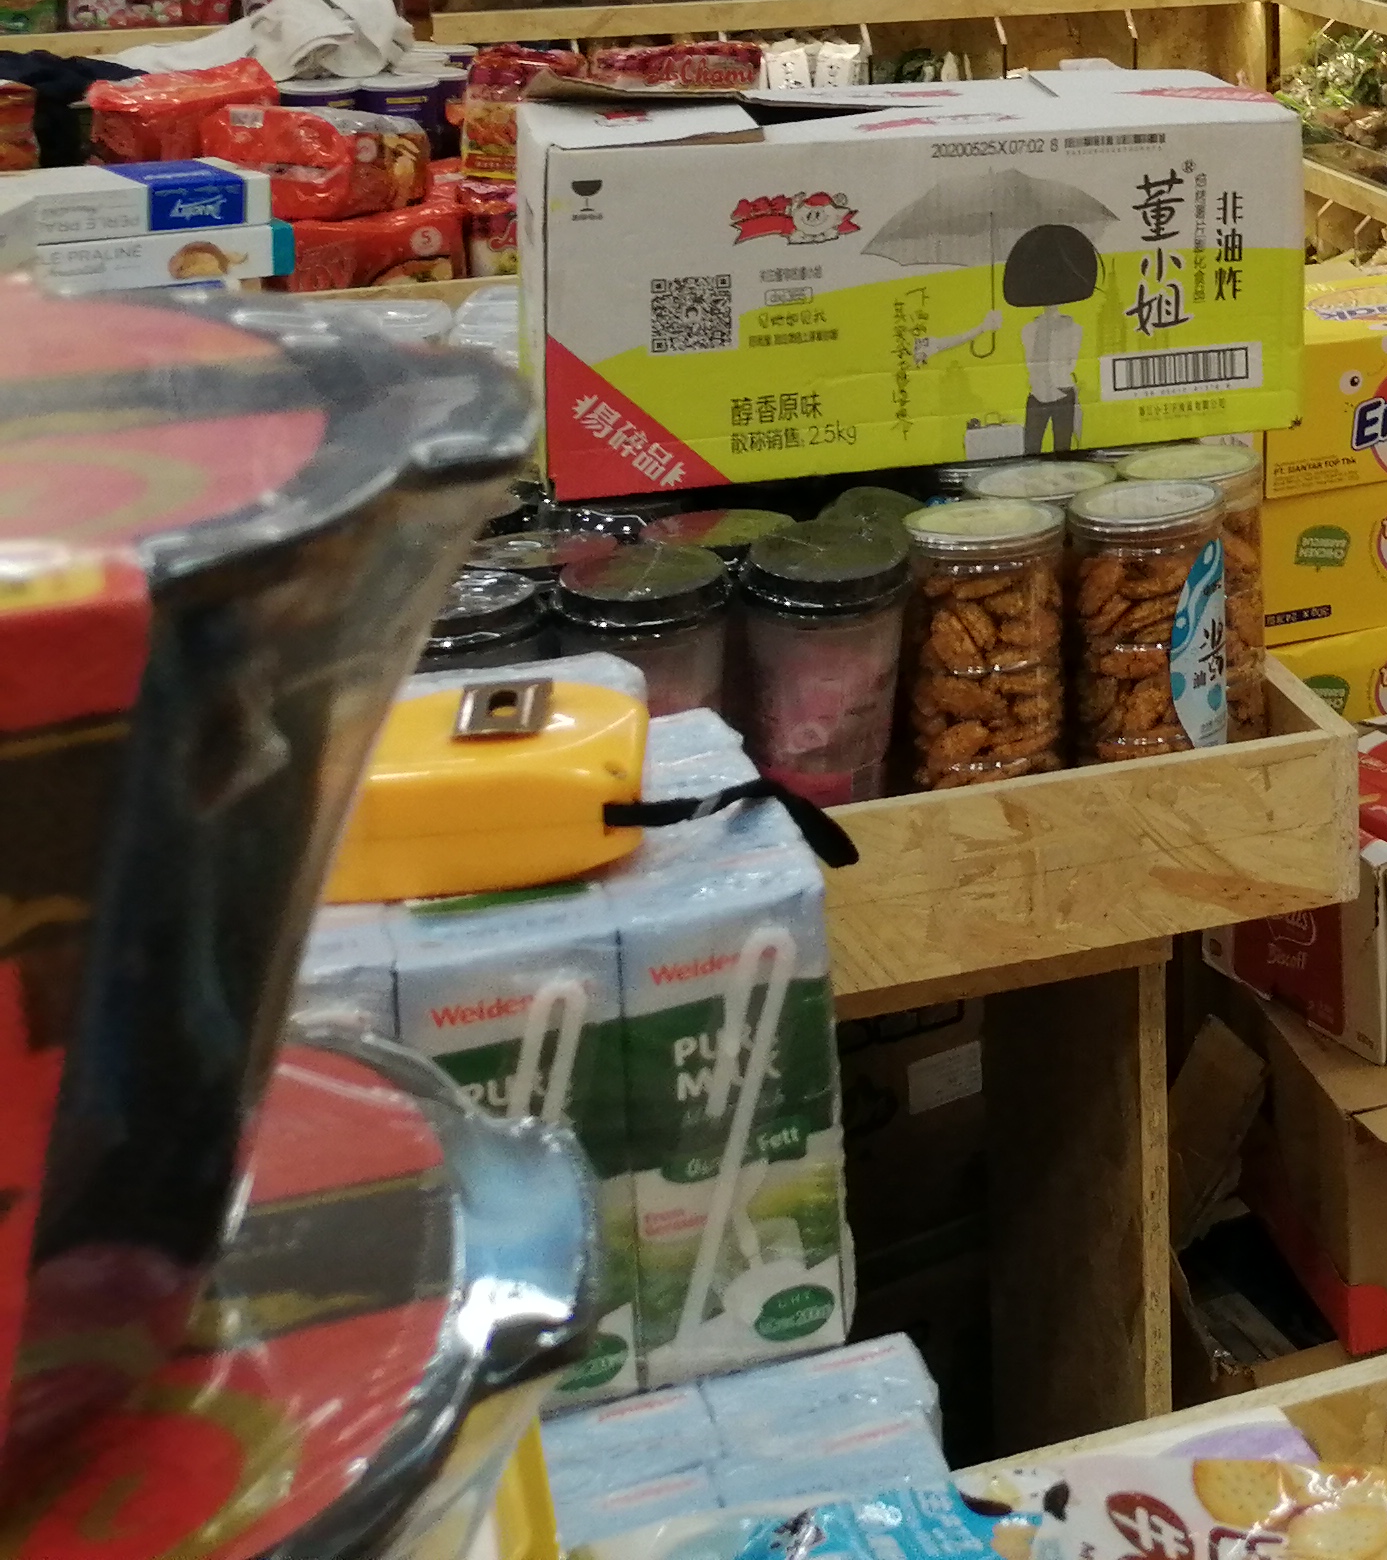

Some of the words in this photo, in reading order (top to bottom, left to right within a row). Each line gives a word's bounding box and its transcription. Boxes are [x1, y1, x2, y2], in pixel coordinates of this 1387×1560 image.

[1126, 168, 1191, 336] 董小姐
[1215, 190, 1244, 301] 非油炸
[730, 391, 824, 428] 醇香原味
